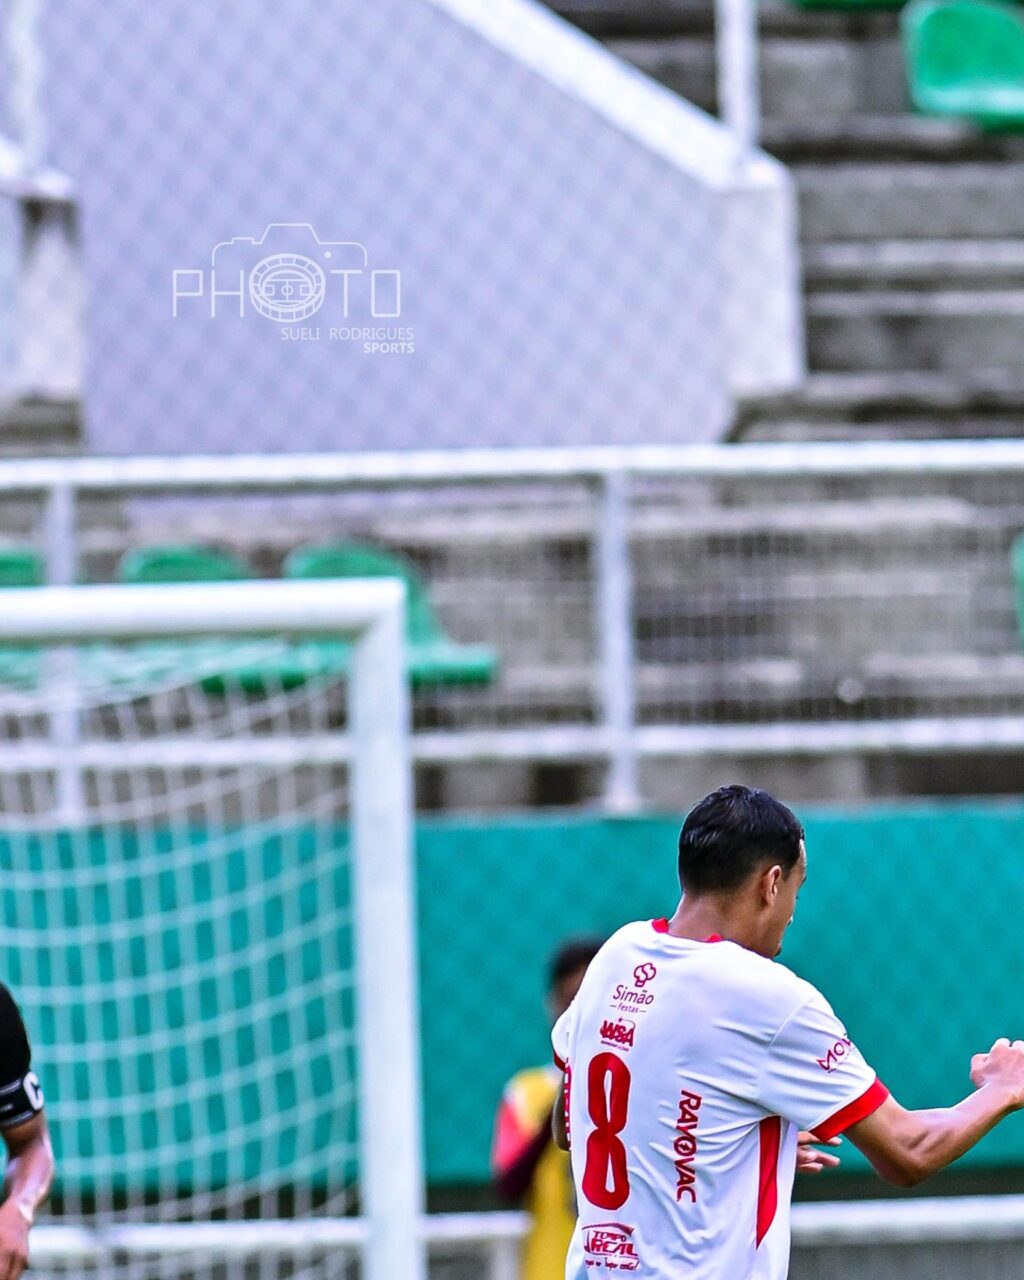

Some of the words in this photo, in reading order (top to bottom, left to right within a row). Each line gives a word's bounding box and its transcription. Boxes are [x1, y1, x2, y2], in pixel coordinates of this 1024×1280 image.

[612, 984, 655, 1005] Simão
[582, 1051, 632, 1211] 8
[673, 1089, 702, 1203] RAYOVAC
[591, 1238, 638, 1257] REAL
